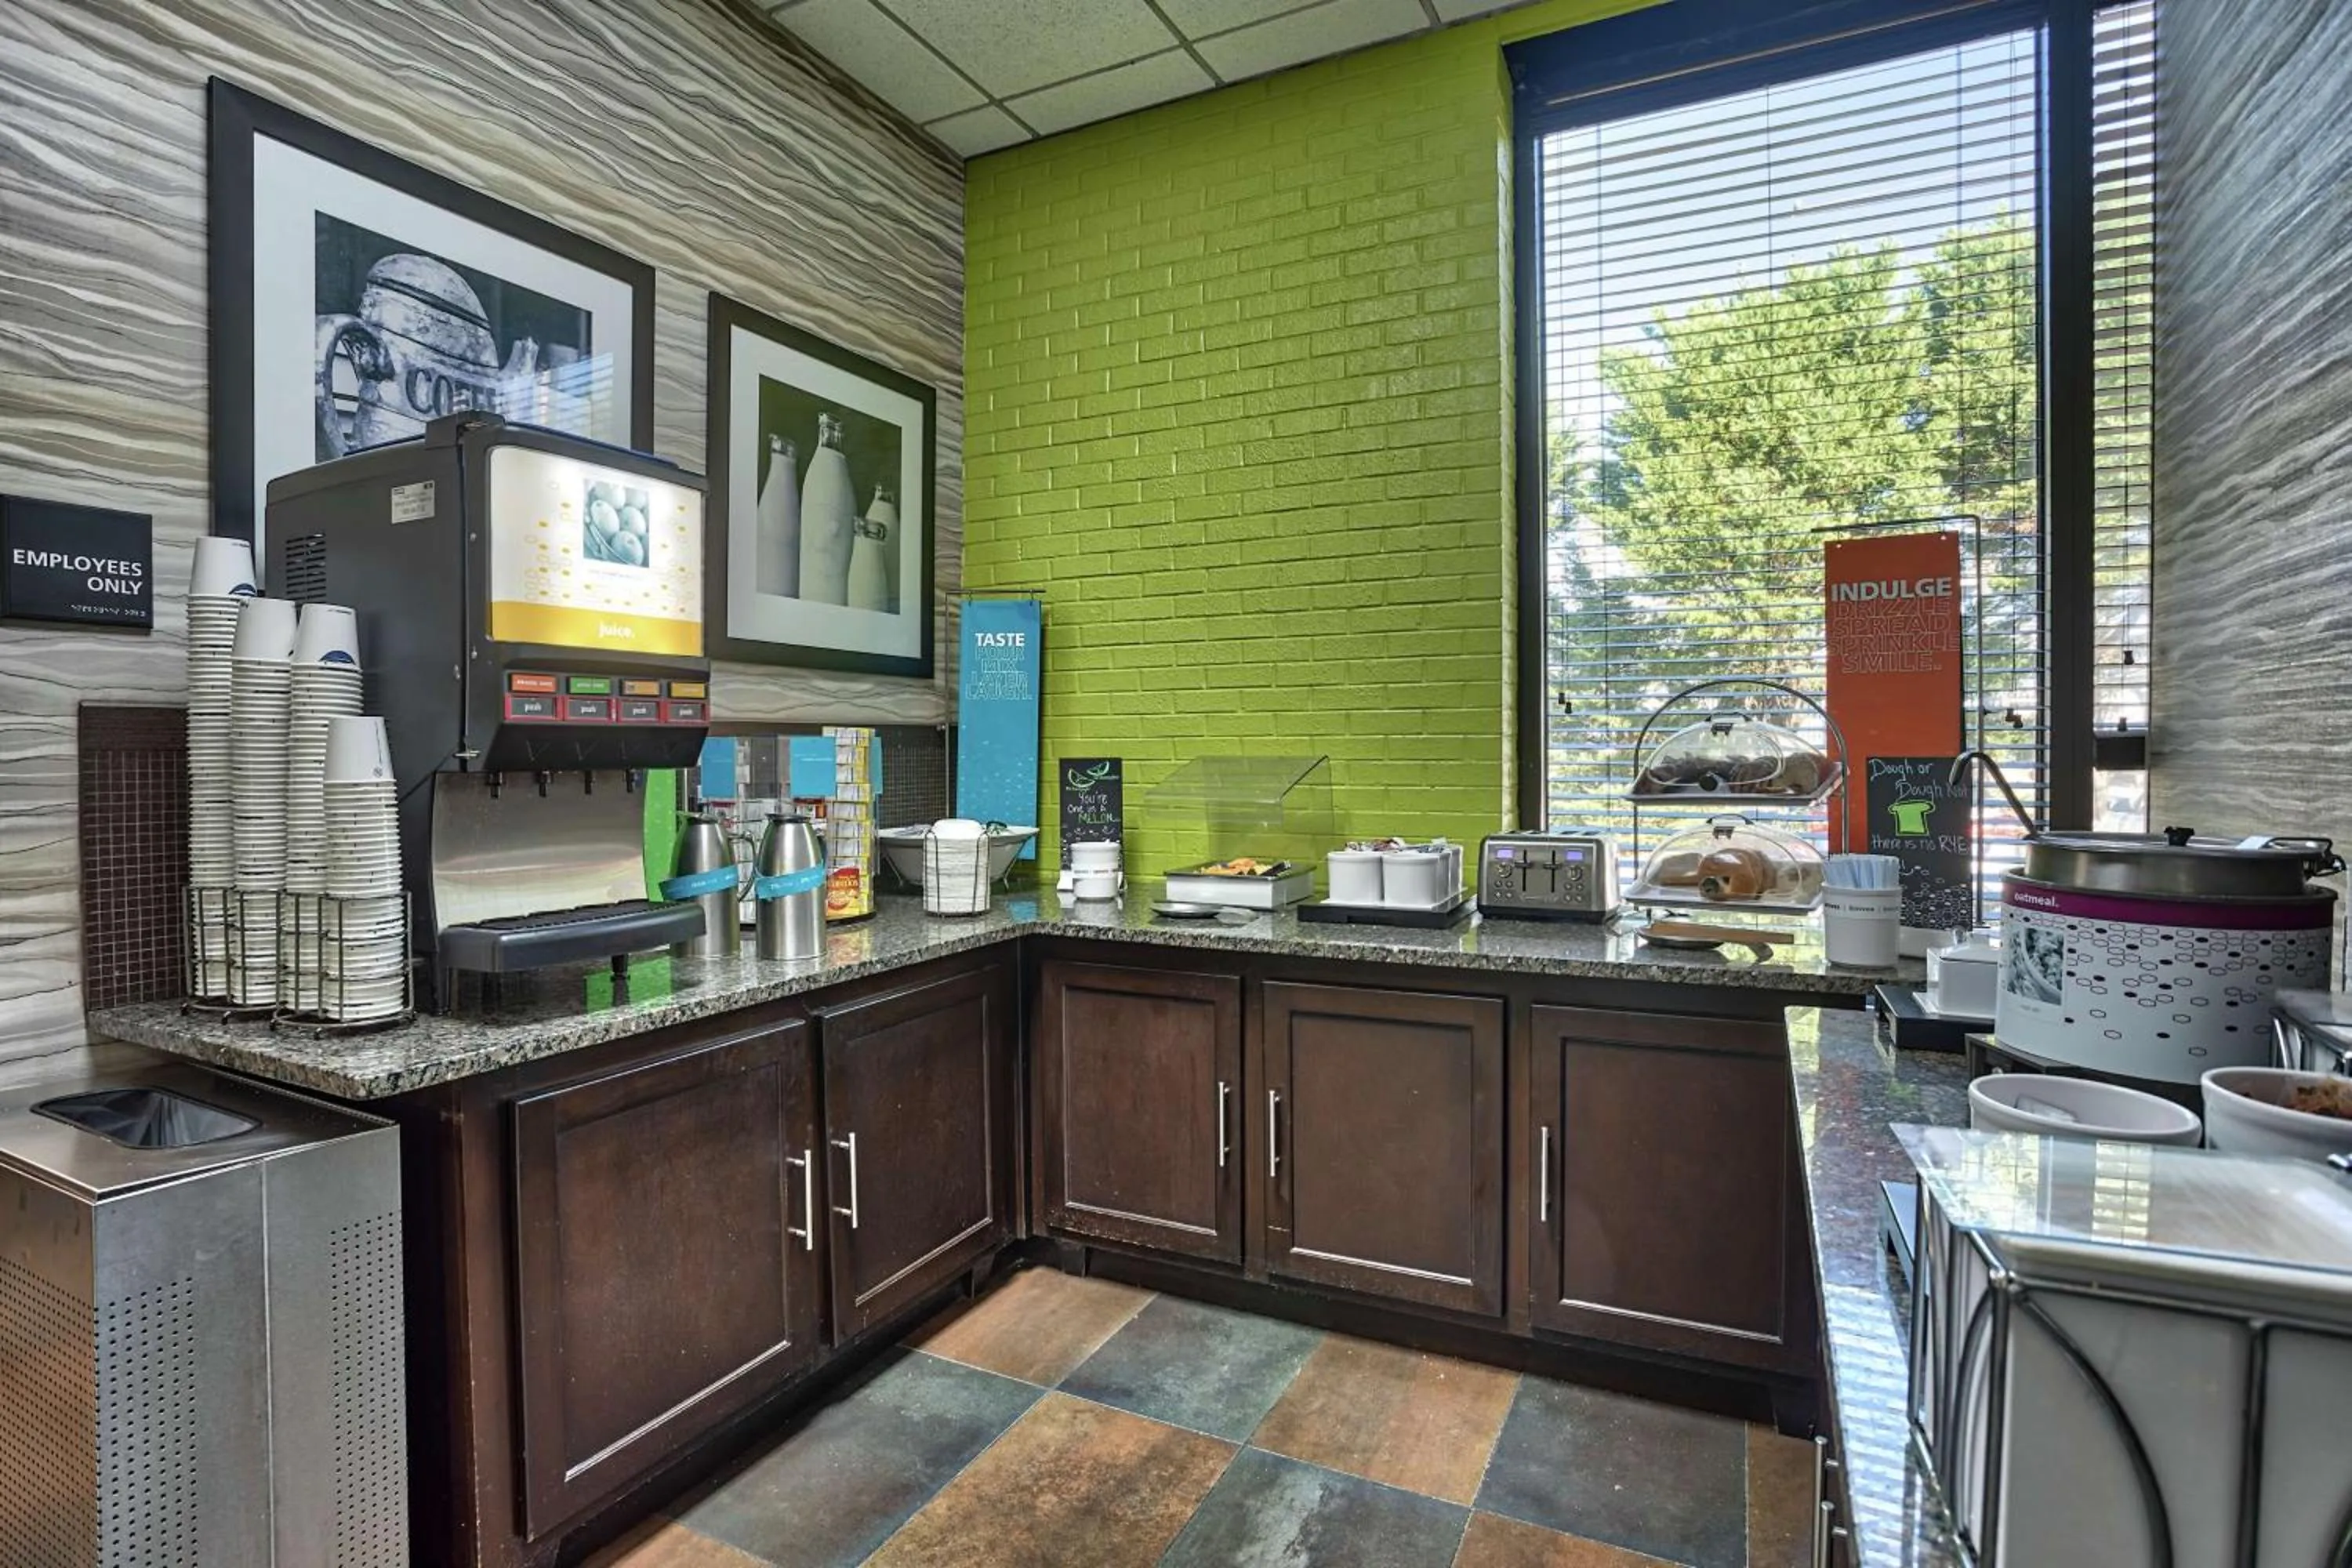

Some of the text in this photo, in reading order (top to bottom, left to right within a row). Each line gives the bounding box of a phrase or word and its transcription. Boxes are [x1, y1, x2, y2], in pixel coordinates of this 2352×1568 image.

[13, 548, 143, 576] EMPLOYEES
[87, 576, 143, 595] ONLY
[1831, 576, 1952, 601] INDULGE
[1834, 597, 1951, 619] DRIZZLE
[1832, 614, 1951, 637] SPREAD
[975, 633, 1025, 647] TASTE
[1828, 632, 1960, 655] SPRINKLE
[1842, 652, 1942, 673] SMILE.
[1869, 758, 1933, 781] Dough or
[1896, 779, 1944, 808] Dough
[1905, 839, 1918, 849] is
[1938, 834, 1970, 855] RYE
